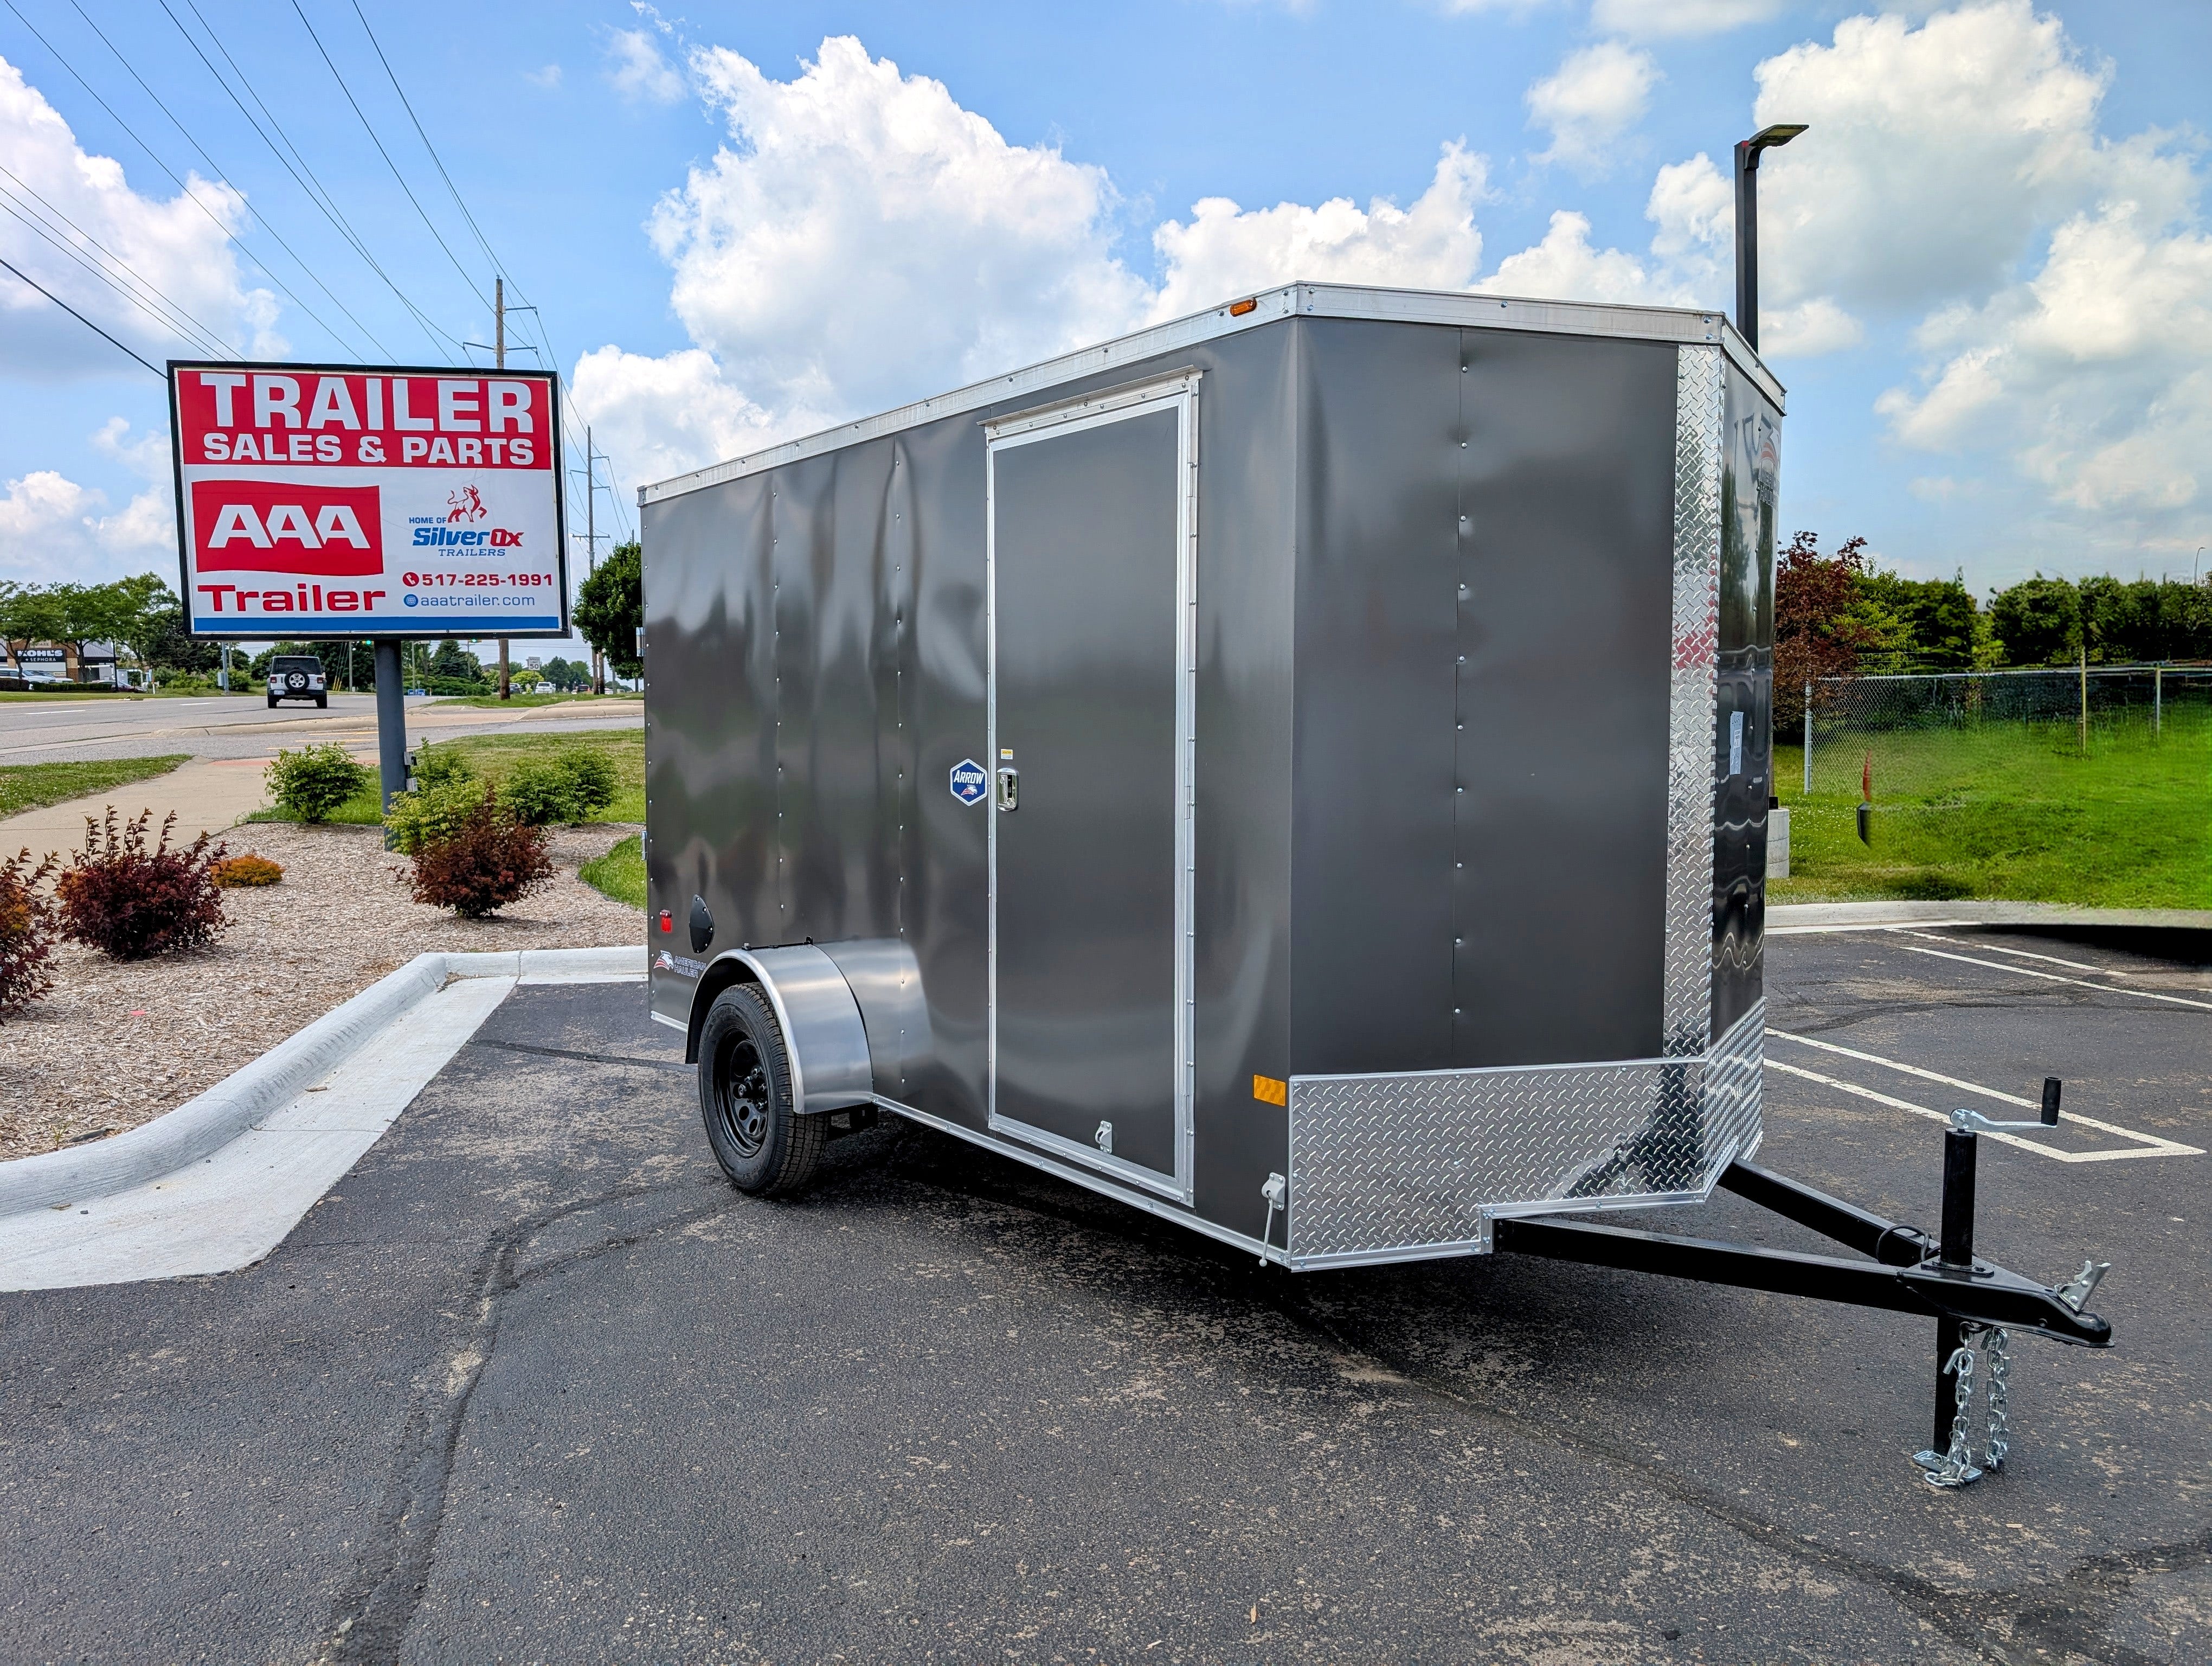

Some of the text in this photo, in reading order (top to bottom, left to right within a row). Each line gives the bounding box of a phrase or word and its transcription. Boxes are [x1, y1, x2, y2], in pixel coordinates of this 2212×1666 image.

[200, 373, 533, 433] TRAILER
[203, 433, 534, 465] SALES & PARTS
[207, 504, 371, 549] AAA
[438, 549, 506, 557] TRAILERS
[422, 574, 552, 586] 517-225-1991
[197, 583, 386, 612] Trailer
[421, 594, 535, 606] aaatrailer.com
[953, 770, 985, 784] ARROW
[674, 956, 706, 971] AMERICAN
[674, 964, 698, 978] HAULER
